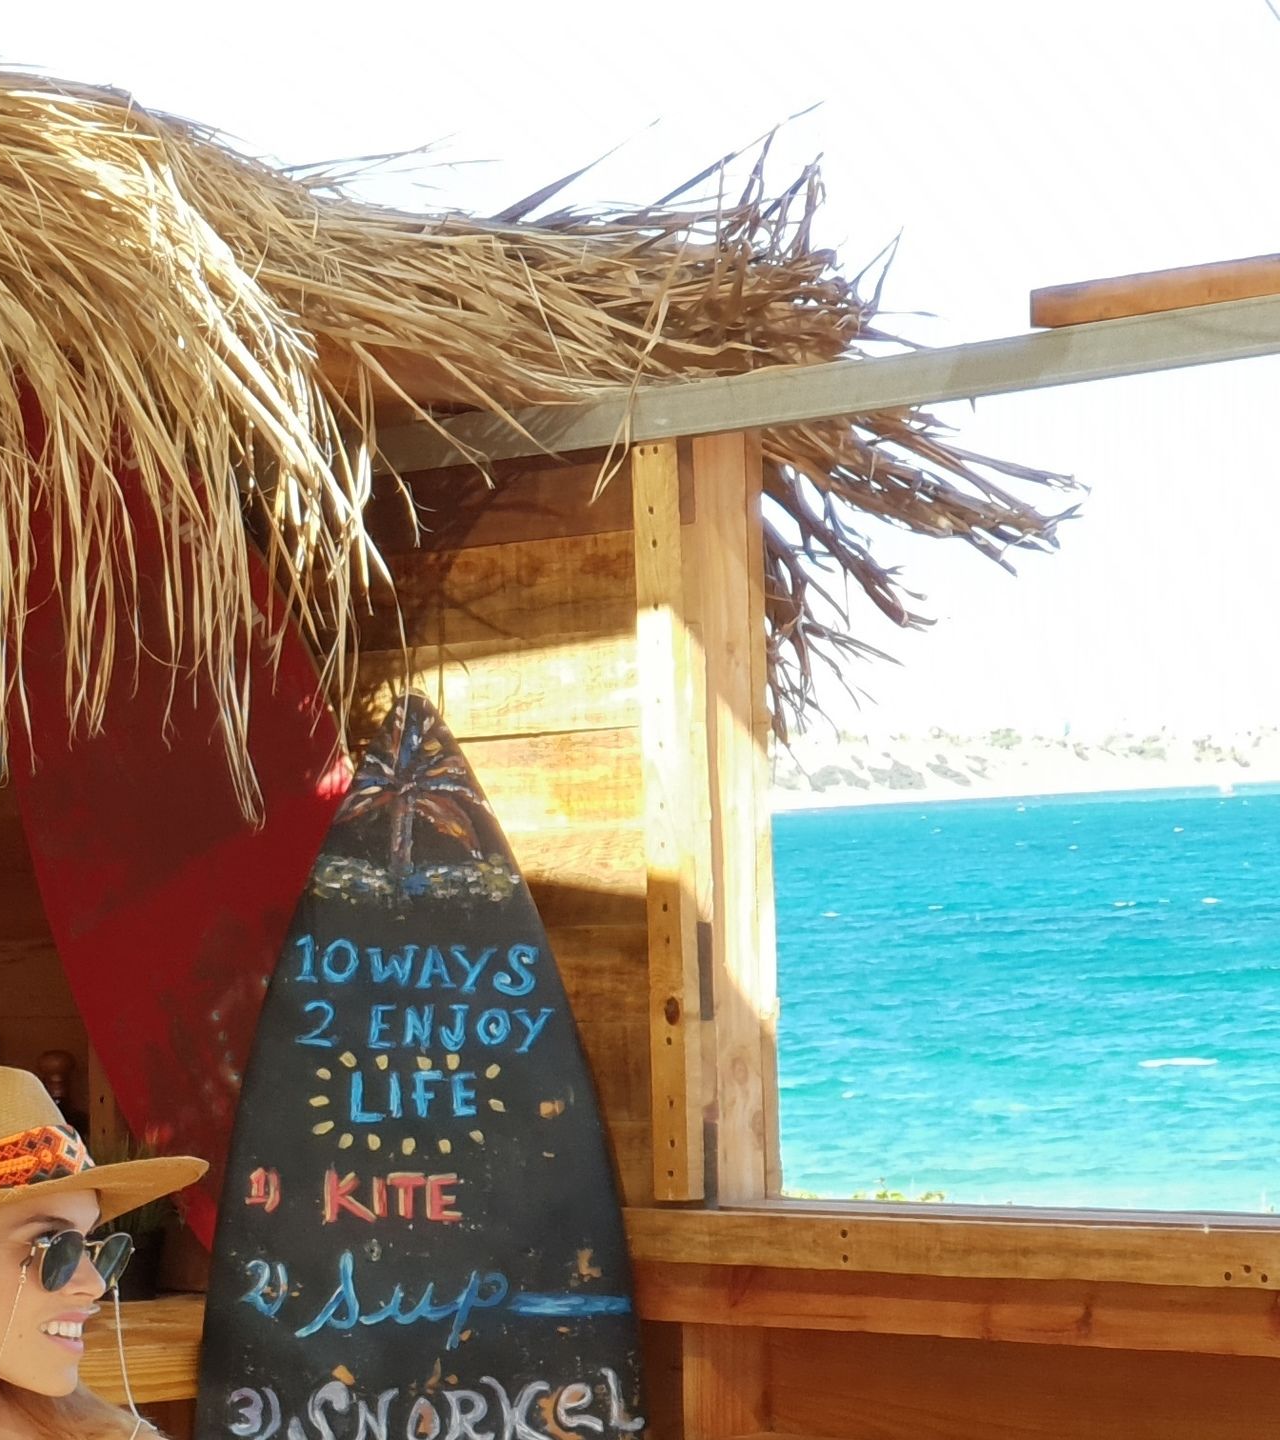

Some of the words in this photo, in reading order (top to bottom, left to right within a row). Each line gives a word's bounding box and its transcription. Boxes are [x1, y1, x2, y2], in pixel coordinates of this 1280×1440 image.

[294, 999, 338, 1049] 2
[367, 1002, 554, 1054] ENJOY
[349, 1069, 479, 1124] LIFE
[321, 1168, 464, 1226] KITE
[240, 1258, 289, 1319] 2)
